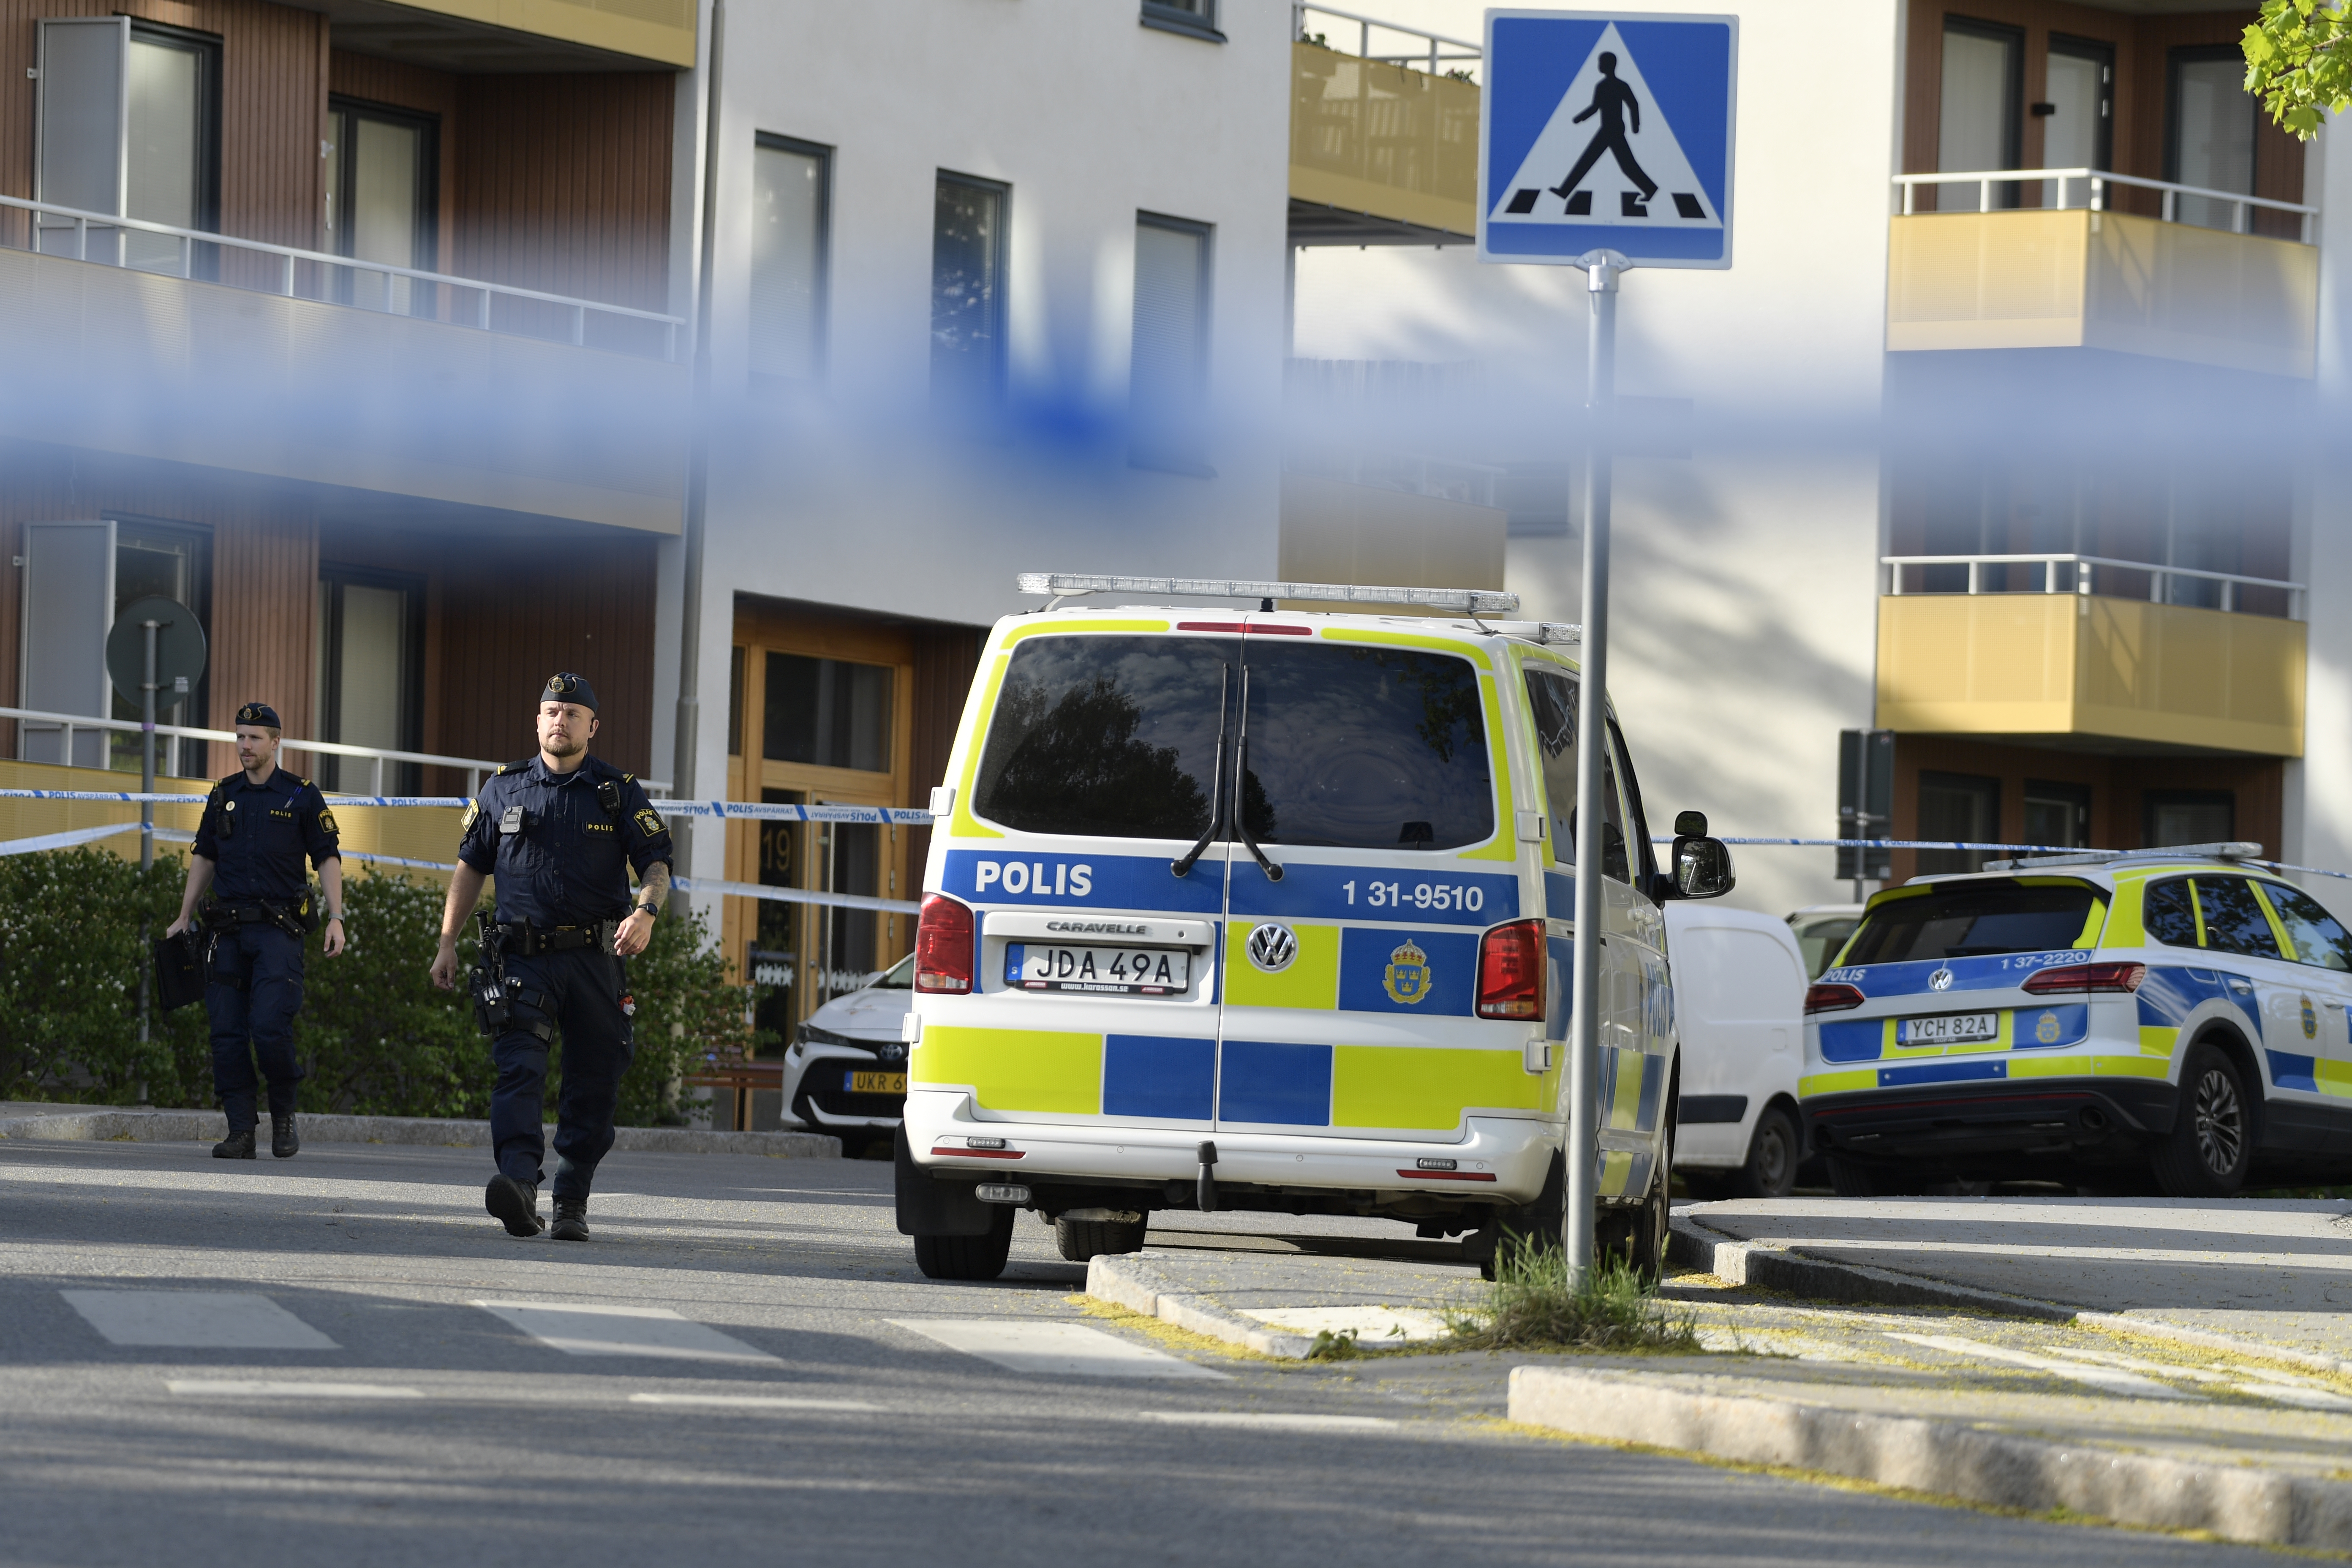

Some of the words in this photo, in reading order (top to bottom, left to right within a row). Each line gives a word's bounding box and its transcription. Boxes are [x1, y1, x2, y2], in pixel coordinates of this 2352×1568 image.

[635, 810, 653, 819] POLIS
[683, 805, 709, 814] POLIS
[727, 803, 753, 813] POLIS
[754, 804, 793, 814] AVSPÄRRAT
[811, 811, 849, 819] AVSPÄRRAT
[894, 811, 921, 819] POLIS
[850, 812, 877, 821] POLIS
[764, 829, 790, 871] 19
[976, 861, 1092, 896] POLIS
[1343, 880, 1355, 905] 1
[1367, 881, 1484, 912] 31-9510
[1045, 921, 1147, 934] CARAVELLE
[1036, 949, 1097, 979] JDA
[1108, 953, 1172, 983] 49A
[2001, 958, 2009, 970] 1
[2014, 952, 2087, 969] 37-2220
[1011, 966, 1018, 975] S
[1821, 969, 1866, 982] POLIS
[1061, 983, 1129, 992] www.karossan.se
[1645, 962, 1666, 1040] POLIS
[1913, 1019, 1946, 1037] YCH
[1952, 1017, 1987, 1034] 82A
[857, 1073, 886, 1089] UKR
[894, 1074, 907, 1090] 6
